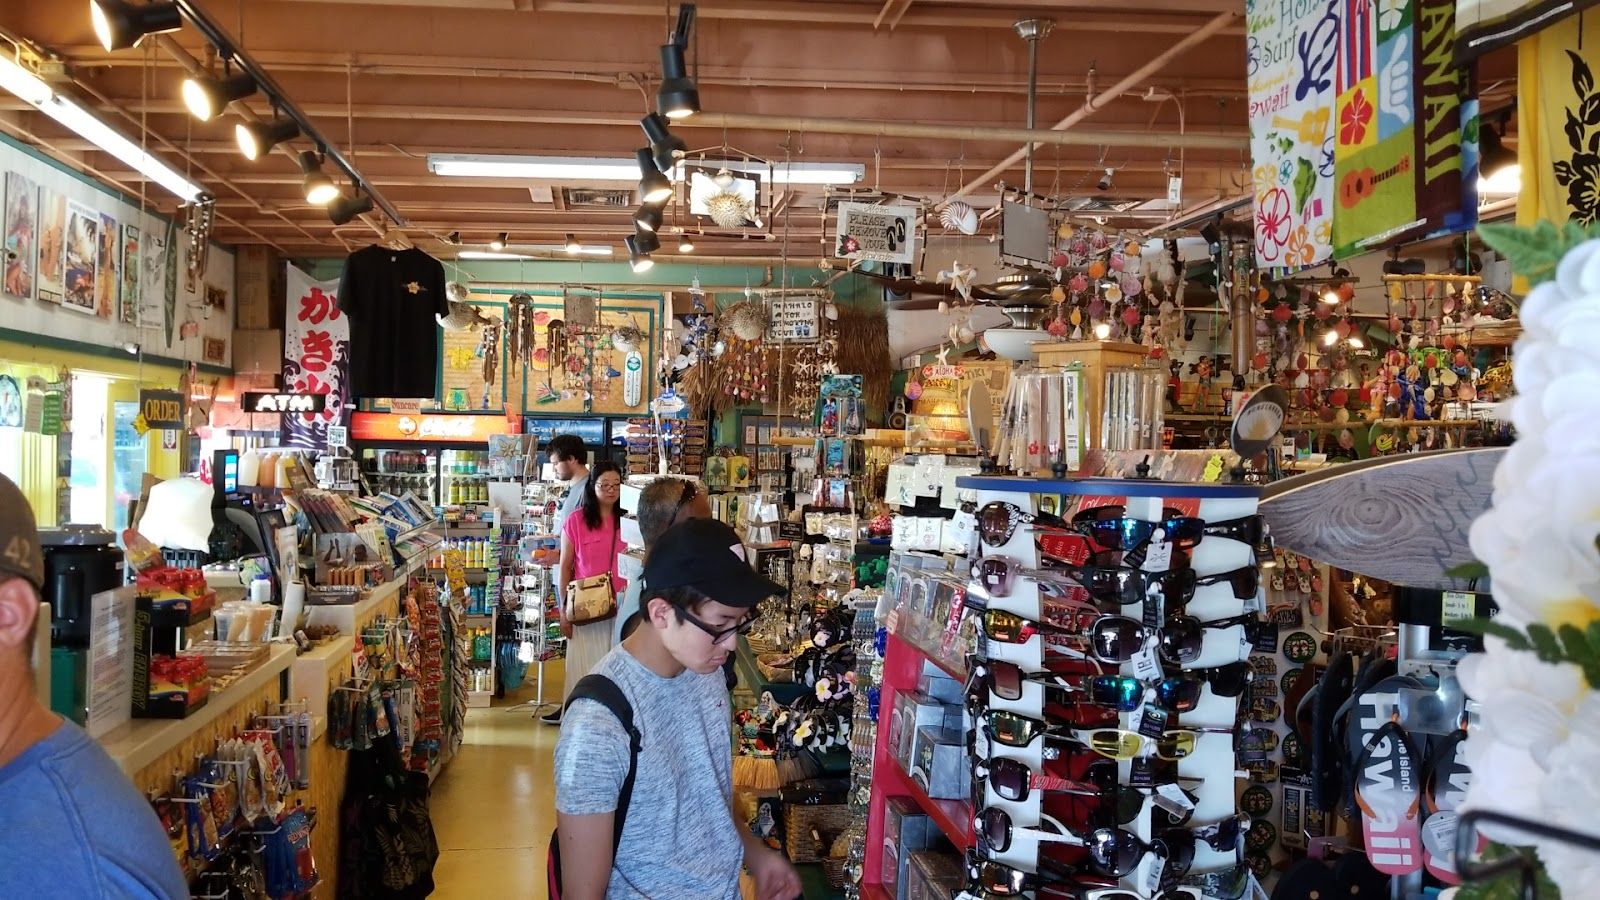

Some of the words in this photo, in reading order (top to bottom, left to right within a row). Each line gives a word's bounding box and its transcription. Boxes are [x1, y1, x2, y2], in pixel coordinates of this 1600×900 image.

[1249, 84, 1289, 118] awaii
[1421, 0, 1462, 186] AWAII
[848, 226, 887, 239] REMOVE
[849, 214, 886, 227] PLEASE
[865, 239, 886, 250] YOUR
[144, 399, 182, 423] ORDER
[255, 394, 314, 412] ATM
[1359, 692, 1413, 866] Hawaii
[1400, 756, 1414, 792] Island
